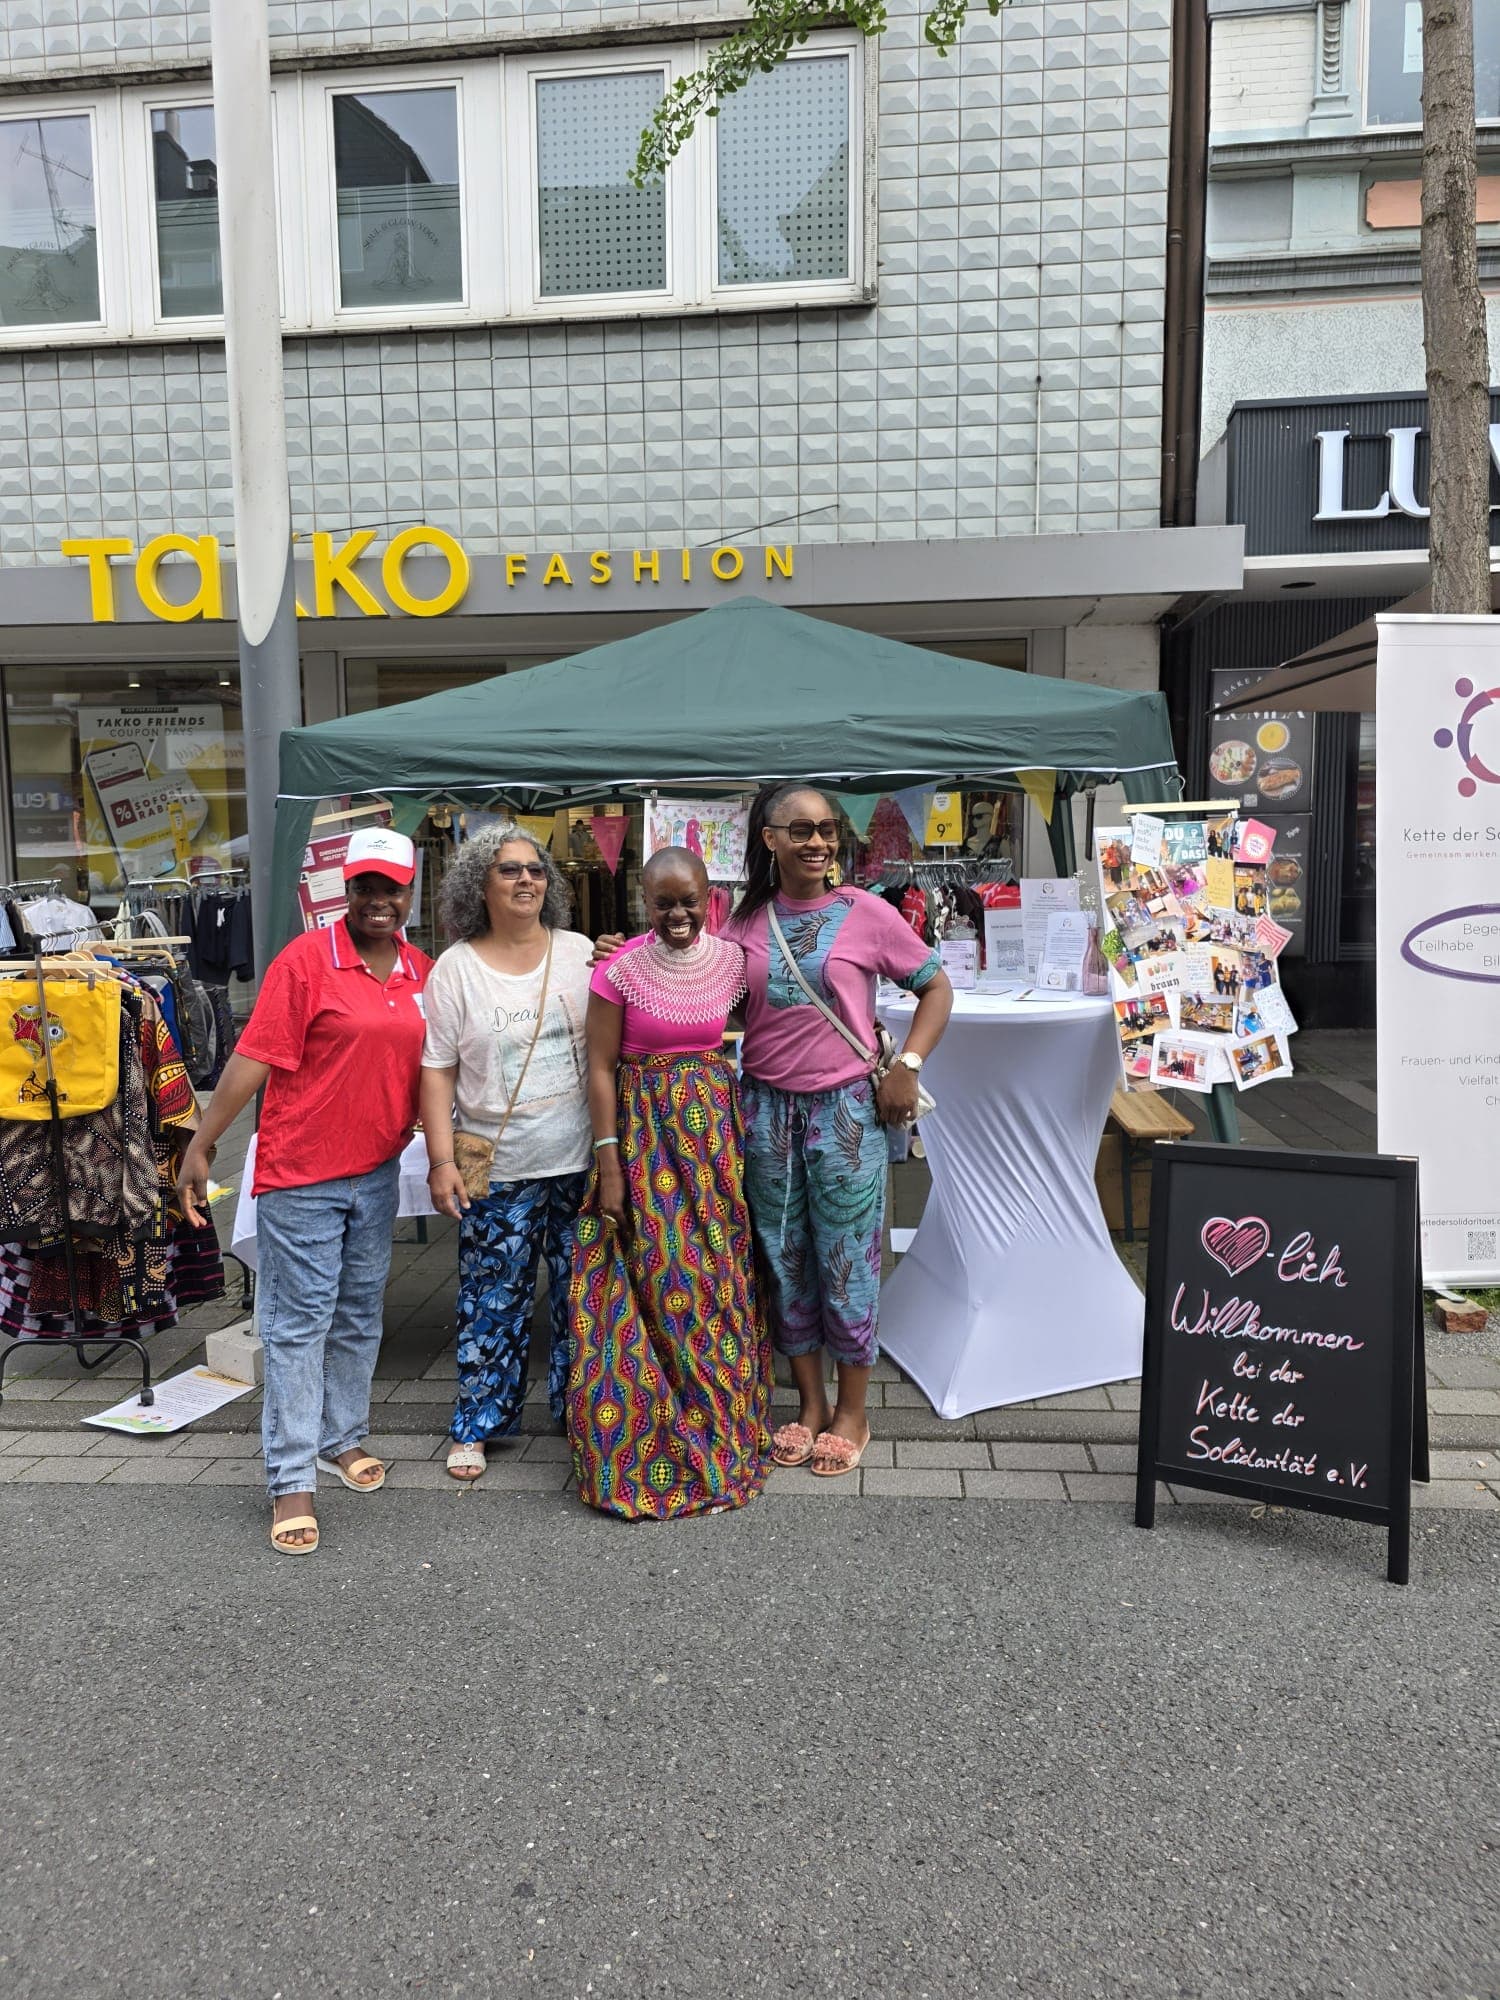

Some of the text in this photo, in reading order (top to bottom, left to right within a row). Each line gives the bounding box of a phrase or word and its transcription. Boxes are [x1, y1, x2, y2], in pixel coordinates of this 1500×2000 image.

[60, 526, 793, 623] TaKO FASHION
[96, 716, 205, 728] TAKKO FRIENDS
[110, 727, 193, 737] COUPON DAYS
[650, 816, 736, 865] WERTE
[1164, 827, 1184, 841] DU
[1403, 827, 1446, 842] Kette
[1453, 826, 1479, 842] der
[1181, 849, 1206, 860] DAS!
[1407, 849, 1497, 860] Gemeinsam wirken
[1463, 923, 1500, 937] Bege
[1417, 940, 1474, 952] Teilhabe
[1150, 977, 1180, 991] braun
[492, 1006, 545, 1033] Drea
[1401, 1055, 1446, 1067] Frauen-
[1449, 1054, 1471, 1065] und
[1459, 1074, 1500, 1086] Vielfalt
[1171, 1282, 1365, 1351] Willkommen
[1232, 1351, 1304, 1384] bei der
[1195, 1379, 1304, 1427] Kette der
[1186, 1425, 1318, 1476] Solidarität
